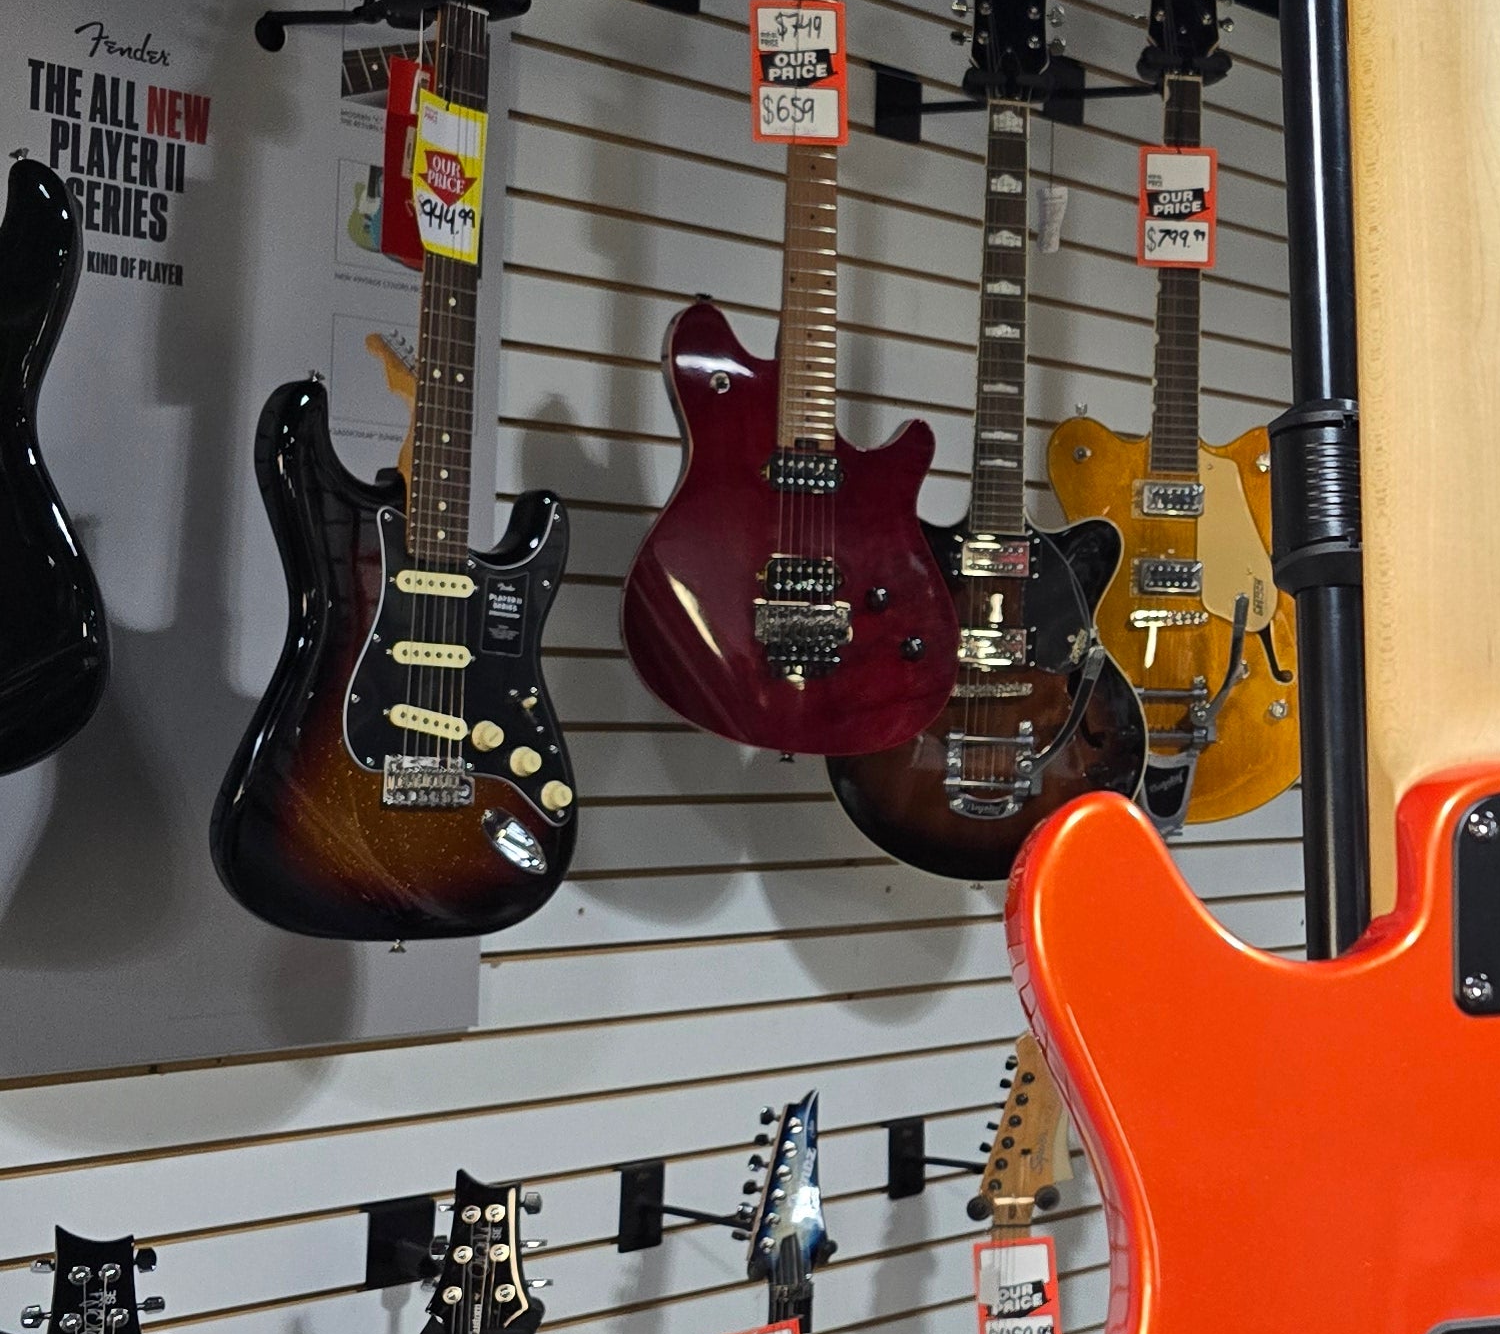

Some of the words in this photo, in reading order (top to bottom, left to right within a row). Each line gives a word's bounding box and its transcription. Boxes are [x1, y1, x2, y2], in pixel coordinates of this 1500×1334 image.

[775, 11, 822, 42] $749
[74, 21, 171, 67] Fender
[774, 52, 817, 67] OUR
[768, 64, 829, 82] PRICE
[28, 58, 83, 119] THE
[88, 72, 139, 132] ALL
[146, 85, 211, 146] NEW
[762, 94, 815, 125] $659
[50, 118, 159, 189] PLAYER
[165, 143, 186, 195] II
[432, 154, 462, 179] OUR
[427, 170, 465, 196] PRICE
[1153, 200, 1202, 216] PRICE
[1159, 190, 1194, 204] OUR
[86, 250, 118, 277] KIND
[120, 256, 137, 280] OF
[138, 259, 184, 287] PLAYER
[104, 1289, 117, 1304] SE
[991, 1292, 1043, 1316] PRICE
[999, 1283, 1033, 1300] OUR
